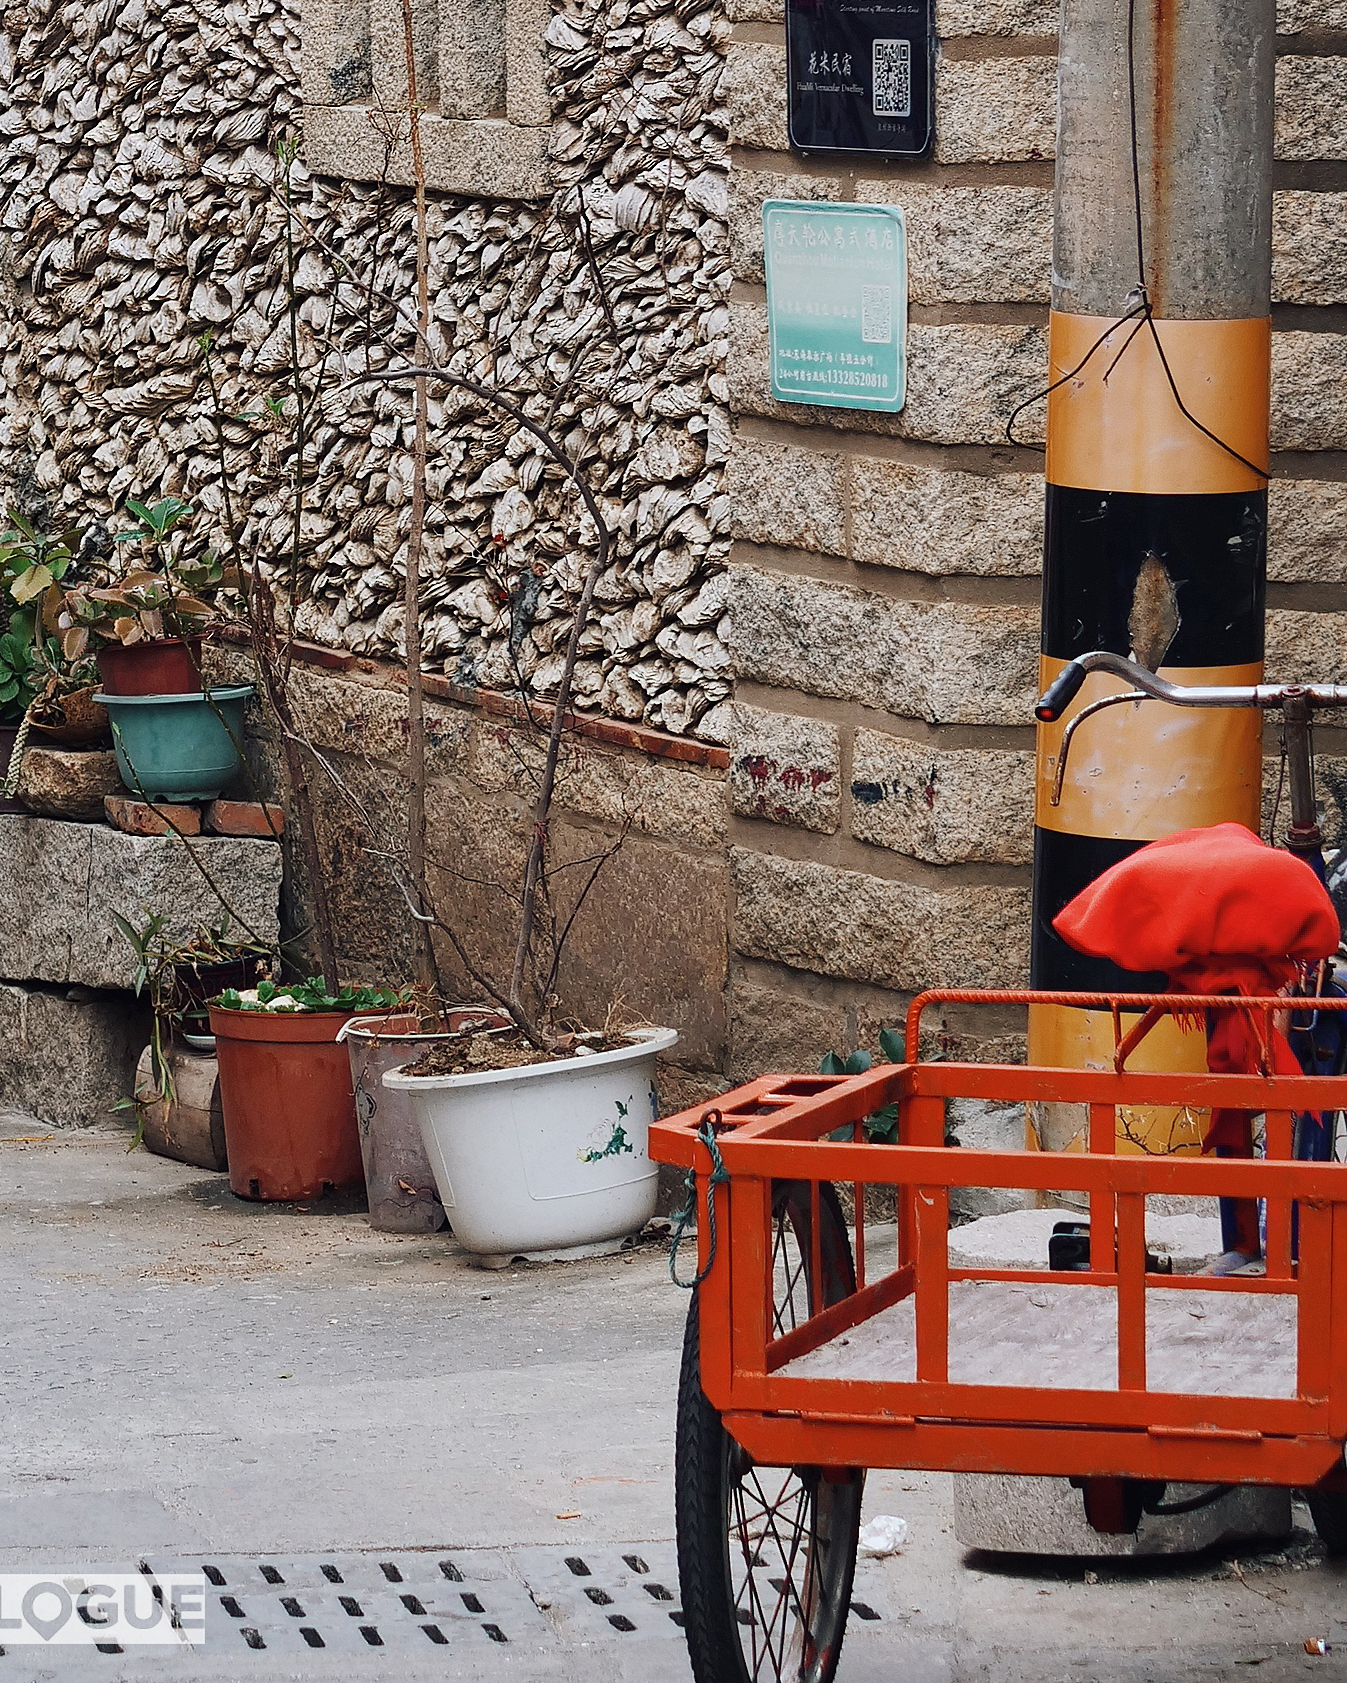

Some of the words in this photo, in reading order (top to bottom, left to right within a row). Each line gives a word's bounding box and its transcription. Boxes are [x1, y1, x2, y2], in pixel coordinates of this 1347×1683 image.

[808, 50, 852, 77] 花米民宿
[842, 84, 864, 96] Dwelling
